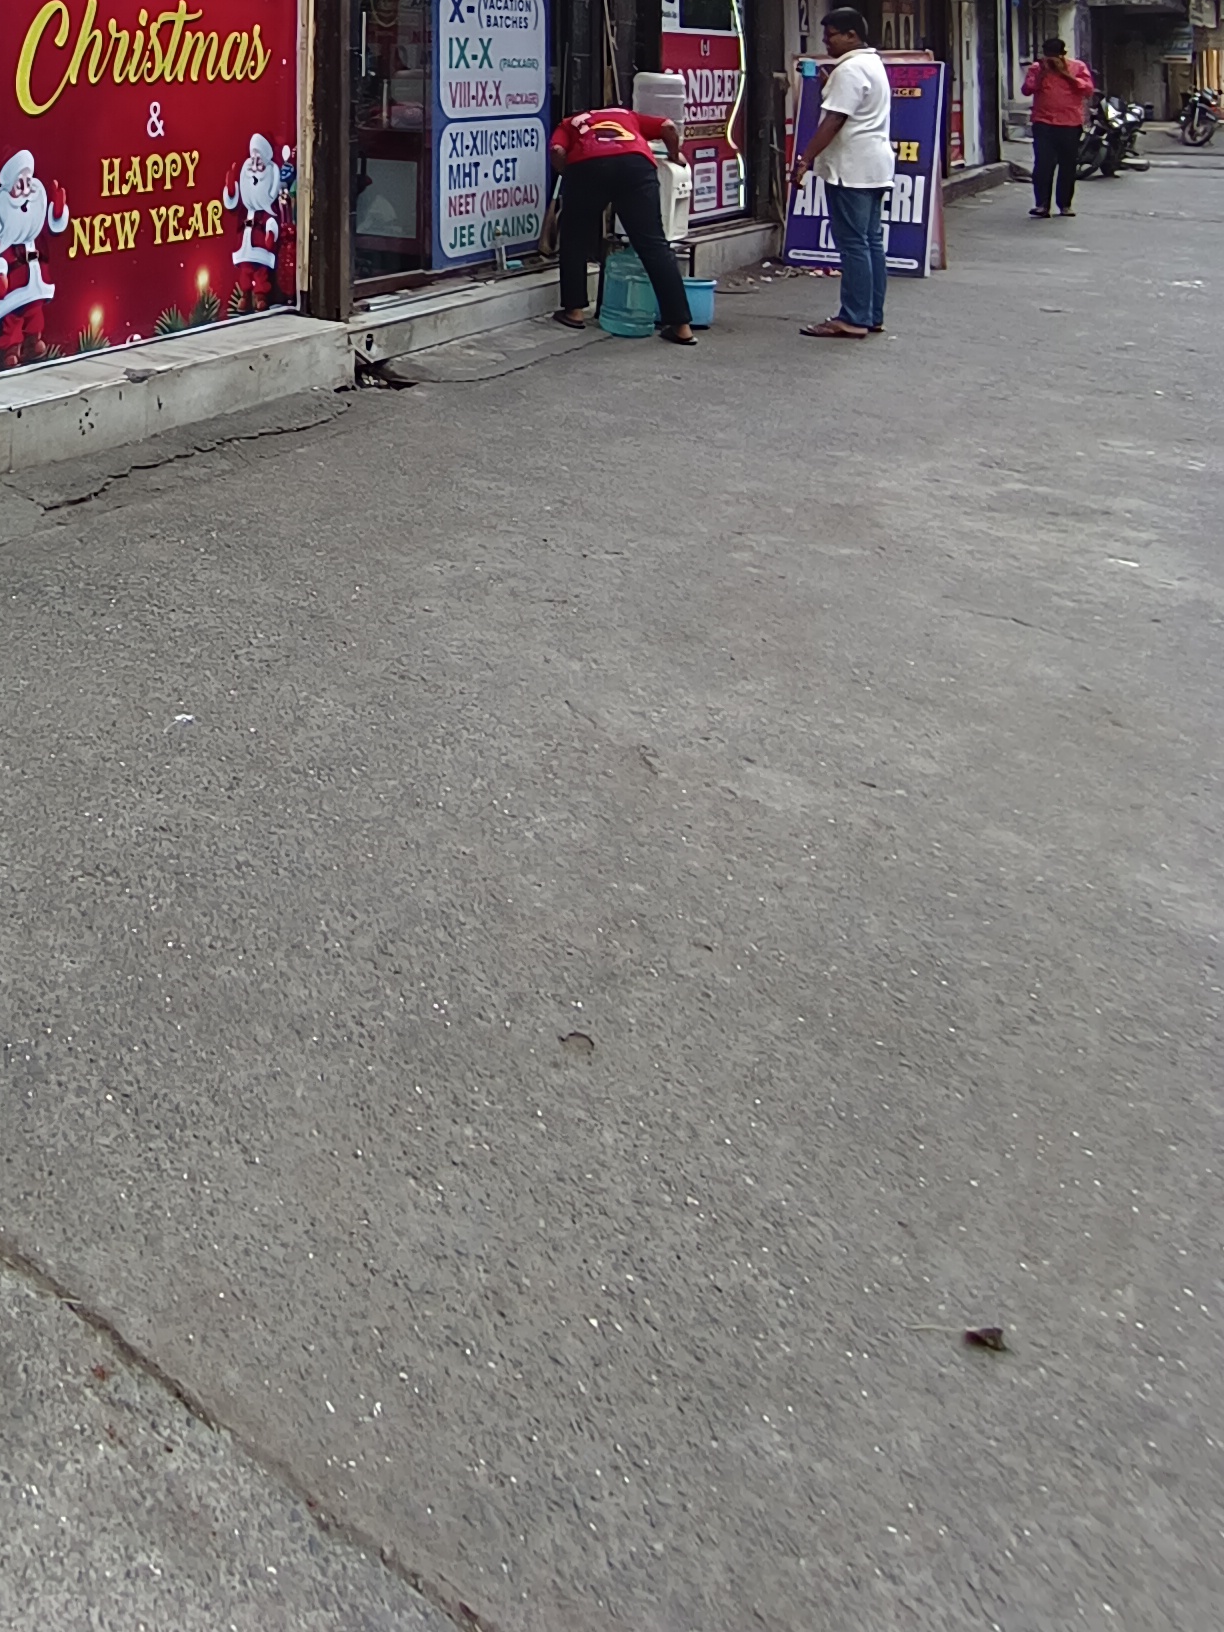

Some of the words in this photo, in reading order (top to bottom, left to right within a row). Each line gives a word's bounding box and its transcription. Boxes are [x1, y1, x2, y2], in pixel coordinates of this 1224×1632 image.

[146, 100, 165, 138] &
[101, 149, 200, 197] HAPPY
[449, 161, 481, 190] MHT
[493, 157, 518, 184] CET
[448, 193, 477, 217] NEET
[480, 183, 540, 218] (MEDICAL)
[68, 208, 141, 259] NEW
[149, 198, 224, 247] YEAR
[449, 224, 475, 249] JEE
